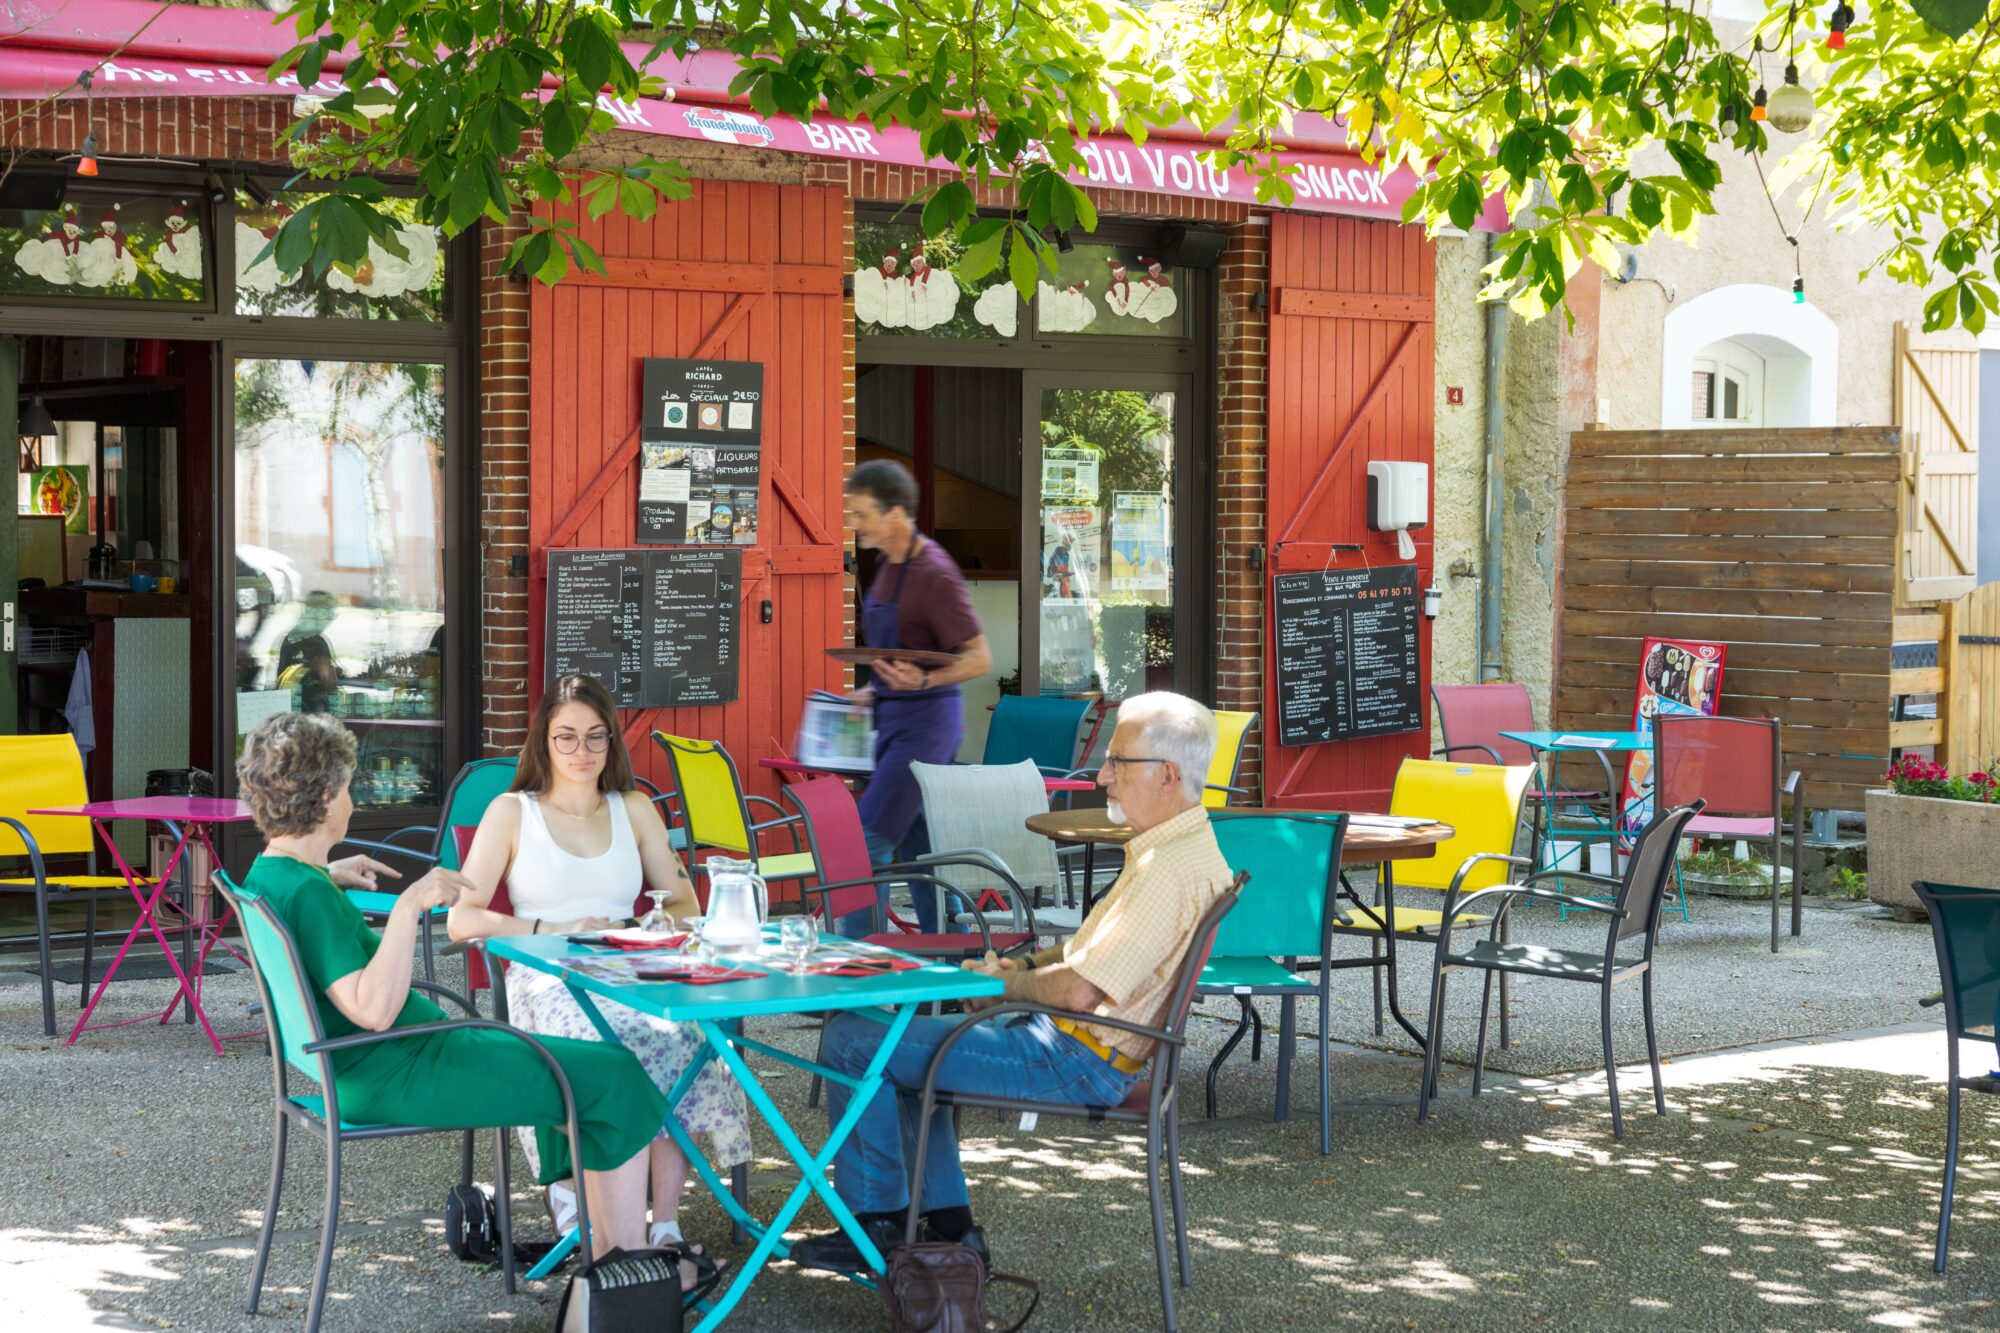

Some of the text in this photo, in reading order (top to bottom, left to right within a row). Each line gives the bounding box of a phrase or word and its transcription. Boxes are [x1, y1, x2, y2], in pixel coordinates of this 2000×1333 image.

[594, 95, 652, 127] AR
[684, 111, 773, 140] Kronenbourg
[800, 120, 880, 155] BAR
[1081, 142, 1134, 184] du
[1139, 147, 1230, 198] Volp
[1292, 163, 1389, 204] SNACK
[685, 372, 722, 381] RICHARD
[1453, 390, 1458, 401] 4
[717, 452, 758, 462] LIQUEURS
[1358, 590, 1367, 599] 05
[1370, 590, 1377, 598] 61
[1379, 589, 1389, 597] 97
[1391, 587, 1400, 596] 50
[1402, 586, 1412, 595] 73
